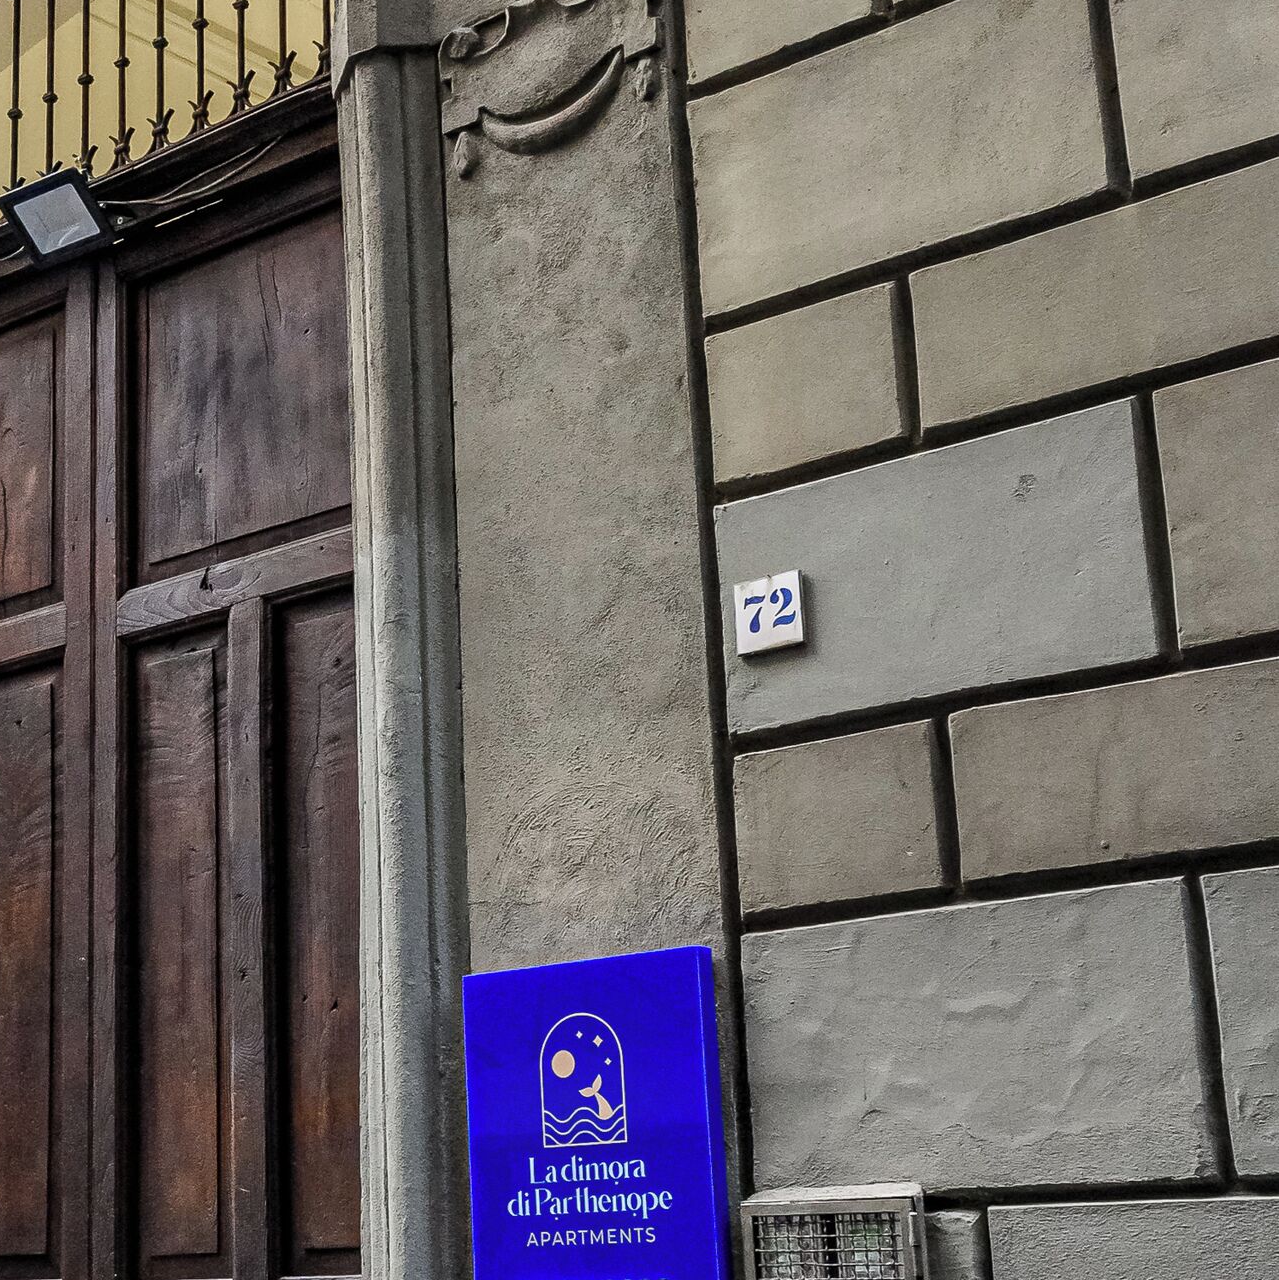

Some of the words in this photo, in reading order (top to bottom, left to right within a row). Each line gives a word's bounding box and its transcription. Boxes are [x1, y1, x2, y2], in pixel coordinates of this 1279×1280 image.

[744, 587, 796, 633] 72
[529, 1157, 558, 1184] La
[561, 1154, 646, 1185] dimora
[507, 1190, 531, 1217] di
[535, 1185, 673, 1220] Parthenope
[526, 1227, 656, 1247] APARTMENTS
